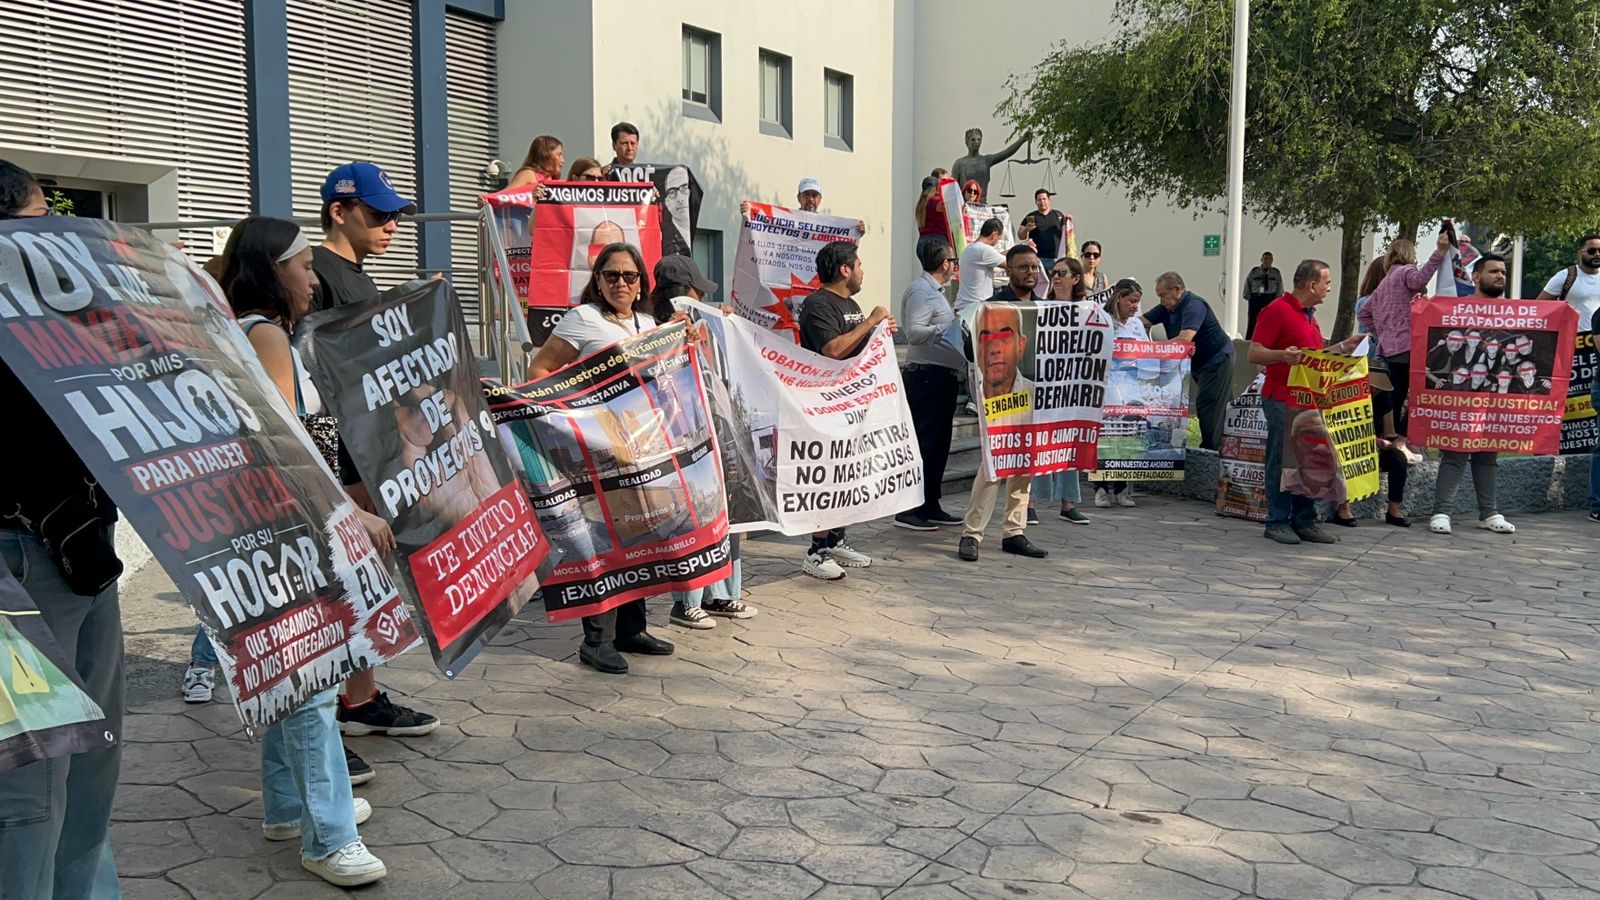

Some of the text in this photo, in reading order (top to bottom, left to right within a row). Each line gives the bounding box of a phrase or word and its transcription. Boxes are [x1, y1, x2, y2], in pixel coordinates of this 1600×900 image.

[744, 220, 800, 239] PROYECTOS
[801, 230, 810, 240] 9
[751, 211, 850, 236] JUSTICIA SELECTIVA
[775, 251, 812, 264] NOSOTROS
[788, 262, 804, 272] NOS
[1442, 315, 1548, 329] ESTAFADORES!
[1453, 303, 1538, 316] ¡FAMILIA DE
[371, 302, 415, 349] SOY
[1036, 329, 1104, 355] AURELIO
[1122, 342, 1140, 353] ERA
[1141, 342, 1154, 353] UN
[1155, 341, 1185, 354] SUEÑO
[110, 353, 184, 382] POR MIS
[361, 332, 459, 412] AFECTADO
[552, 363, 608, 396] nuestros
[1036, 352, 1107, 383] LOBATÓN
[571, 379, 630, 407] EXPECTATIVA
[820, 373, 878, 401] DINERO?
[1034, 384, 1105, 411] BERNARD
[63, 369, 261, 462] HIJOS
[420, 389, 454, 434] DE
[814, 400, 856, 416] DONDE
[991, 393, 1030, 414] ENGAÑO!
[1410, 408, 1457, 421] ¿DONDE
[1499, 413, 1562, 425] NUESTROS
[1430, 421, 1537, 435] DEPARTAMENTOS?
[1025, 432, 1033, 446] 9
[1035, 431, 1048, 447] NO
[1051, 425, 1098, 445] CUMPLIÓ
[1426, 435, 1534, 451] ¡NOS ROBARON!
[1567, 429, 1590, 440] NOS
[790, 440, 824, 460] NO
[1033, 447, 1077, 468] JUSTICIA!
[131, 441, 249, 492] PARA HACER
[379, 409, 497, 519] PROYECTOS 9
[796, 465, 827, 486] NO
[1104, 460, 1120, 469] SON
[1120, 460, 1150, 469] NUESTROS
[1232, 467, 1264, 481] 5 AÑOS
[618, 468, 662, 488] REALIDAD
[782, 466, 922, 513] EXIGIMOS JUSTICIA
[151, 465, 300, 551] JUSTICIA
[534, 488, 578, 510] REALIDAD
[230, 528, 274, 554] POR SU
[428, 545, 460, 582] TE
[458, 499, 514, 555] INVITO
[514, 487, 529, 514] A
[625, 536, 697, 560] MOCA AMARILLO
[444, 520, 540, 617] DENUNCIAR
[553, 559, 606, 578] MOCA VERDE
[193, 536, 328, 630] HOGAR
[561, 568, 651, 605] ¡EXIGIMOS
[245, 605, 326, 660] QUE PAGAMOS Y
[242, 619, 345, 693] NO NOS ENTREGARON
